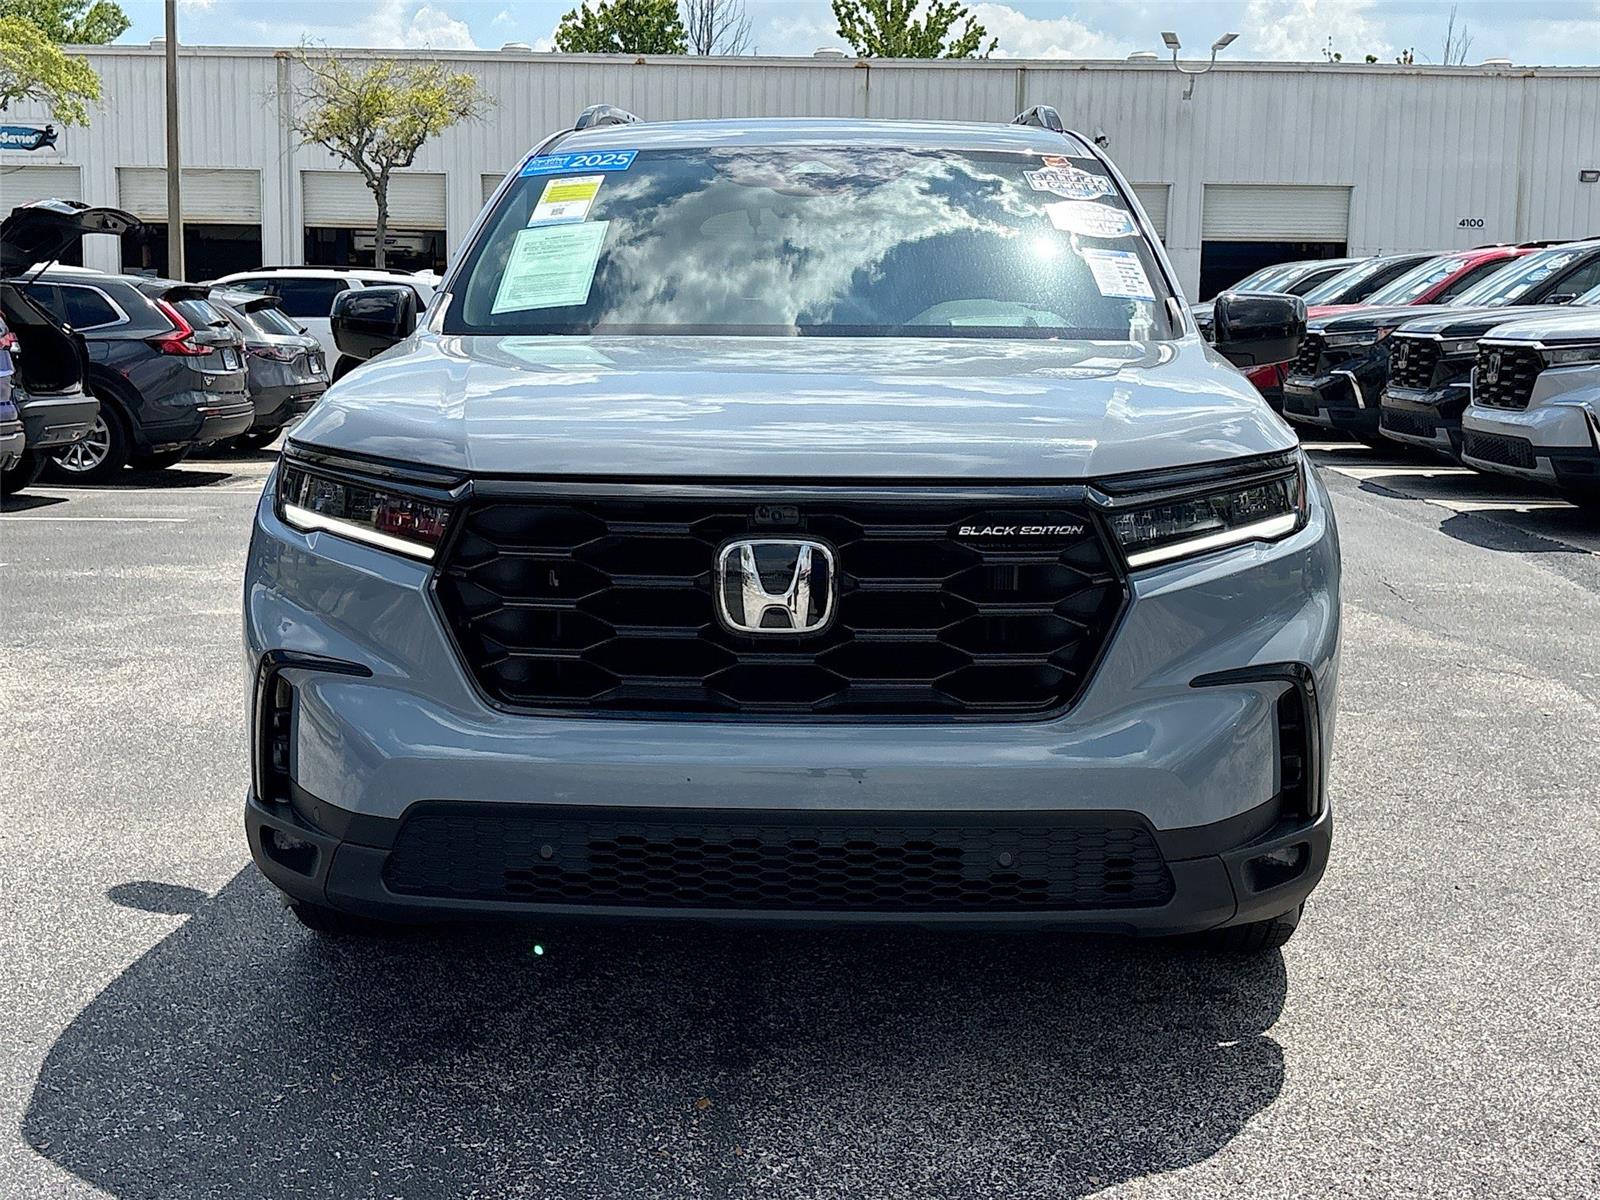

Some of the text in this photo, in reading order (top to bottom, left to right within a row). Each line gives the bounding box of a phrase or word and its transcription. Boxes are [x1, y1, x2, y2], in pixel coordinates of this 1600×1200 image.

[569, 153, 631, 168] 2025
[1458, 218, 1485, 228] 4100
[958, 525, 1084, 536] BLACK EDITION
